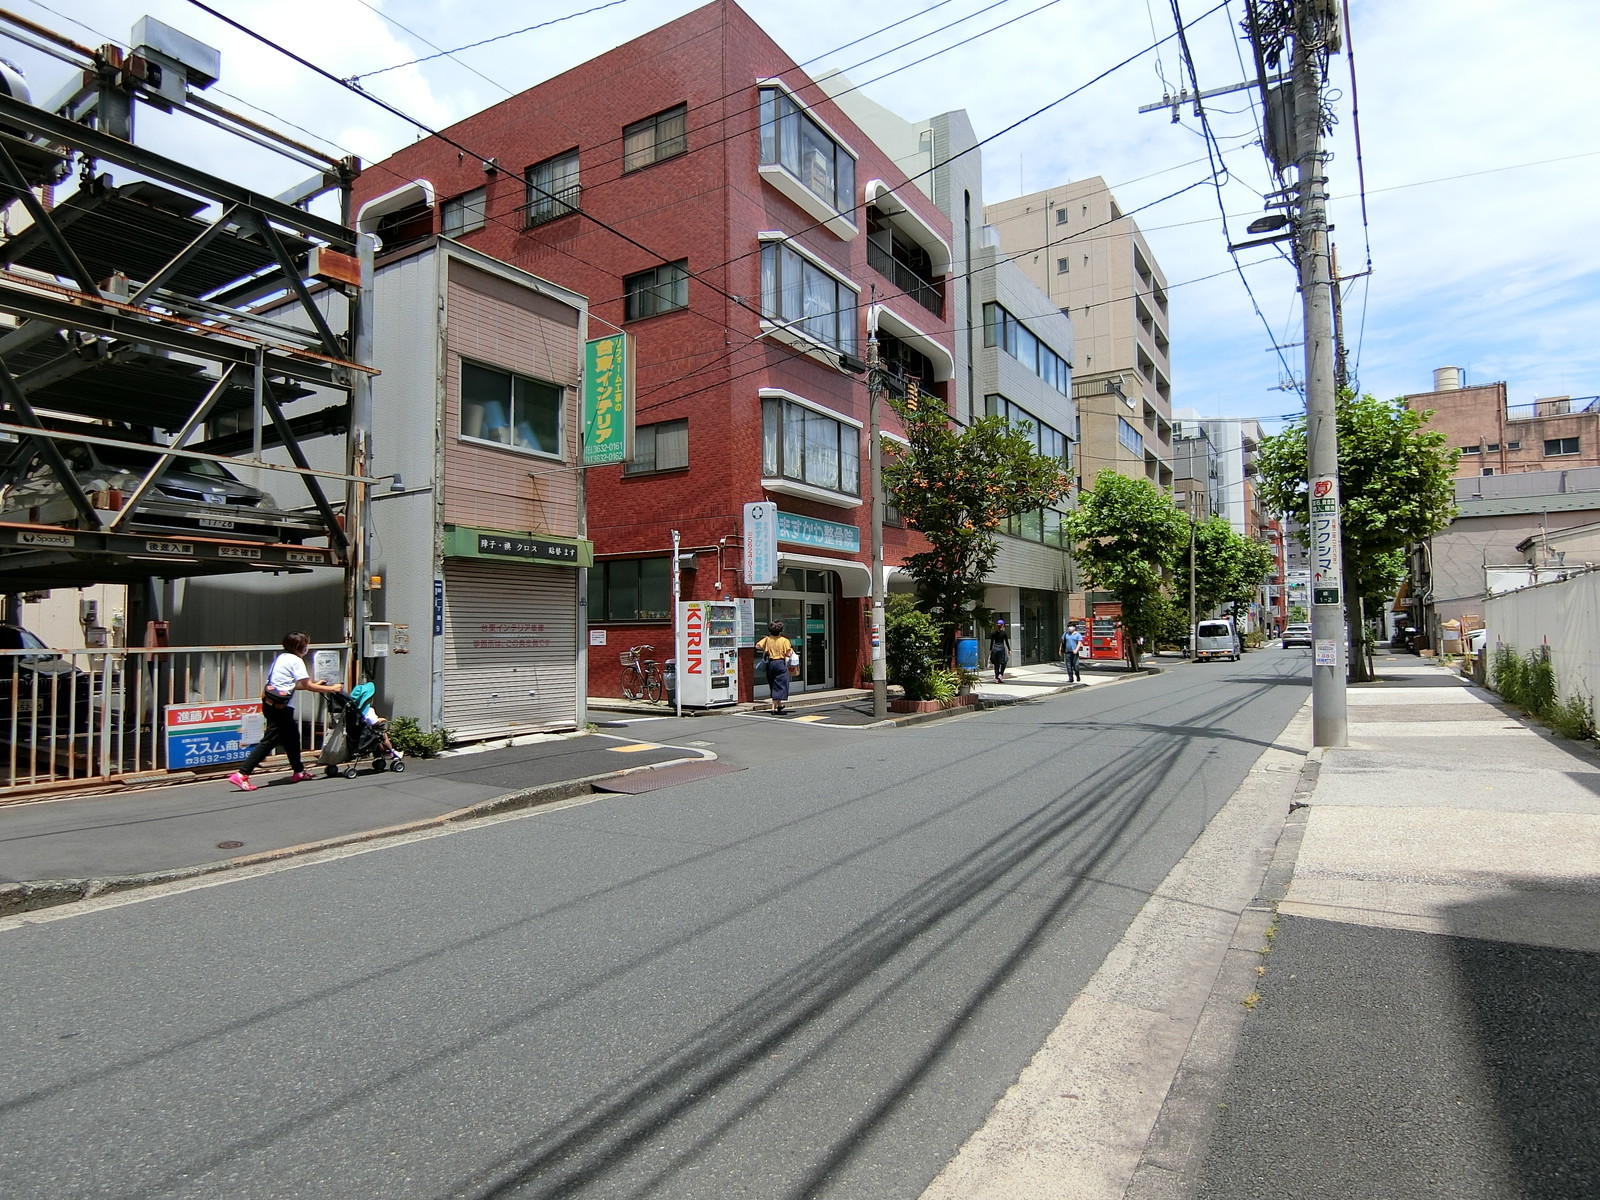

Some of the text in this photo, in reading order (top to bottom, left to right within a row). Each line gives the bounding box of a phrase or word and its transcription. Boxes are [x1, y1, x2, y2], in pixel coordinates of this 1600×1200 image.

[595, 339, 614, 443] 台東インテリア
[149, 543, 192, 554] 後進入庫
[516, 543, 538, 552] クロス
[1317, 519, 1331, 569] フクシマ
[220, 547, 259, 558] 安全確認
[290, 553, 323, 562] 無人確認
[687, 609, 703, 674] KIRIN
[177, 705, 259, 723] 進藤パーキング
